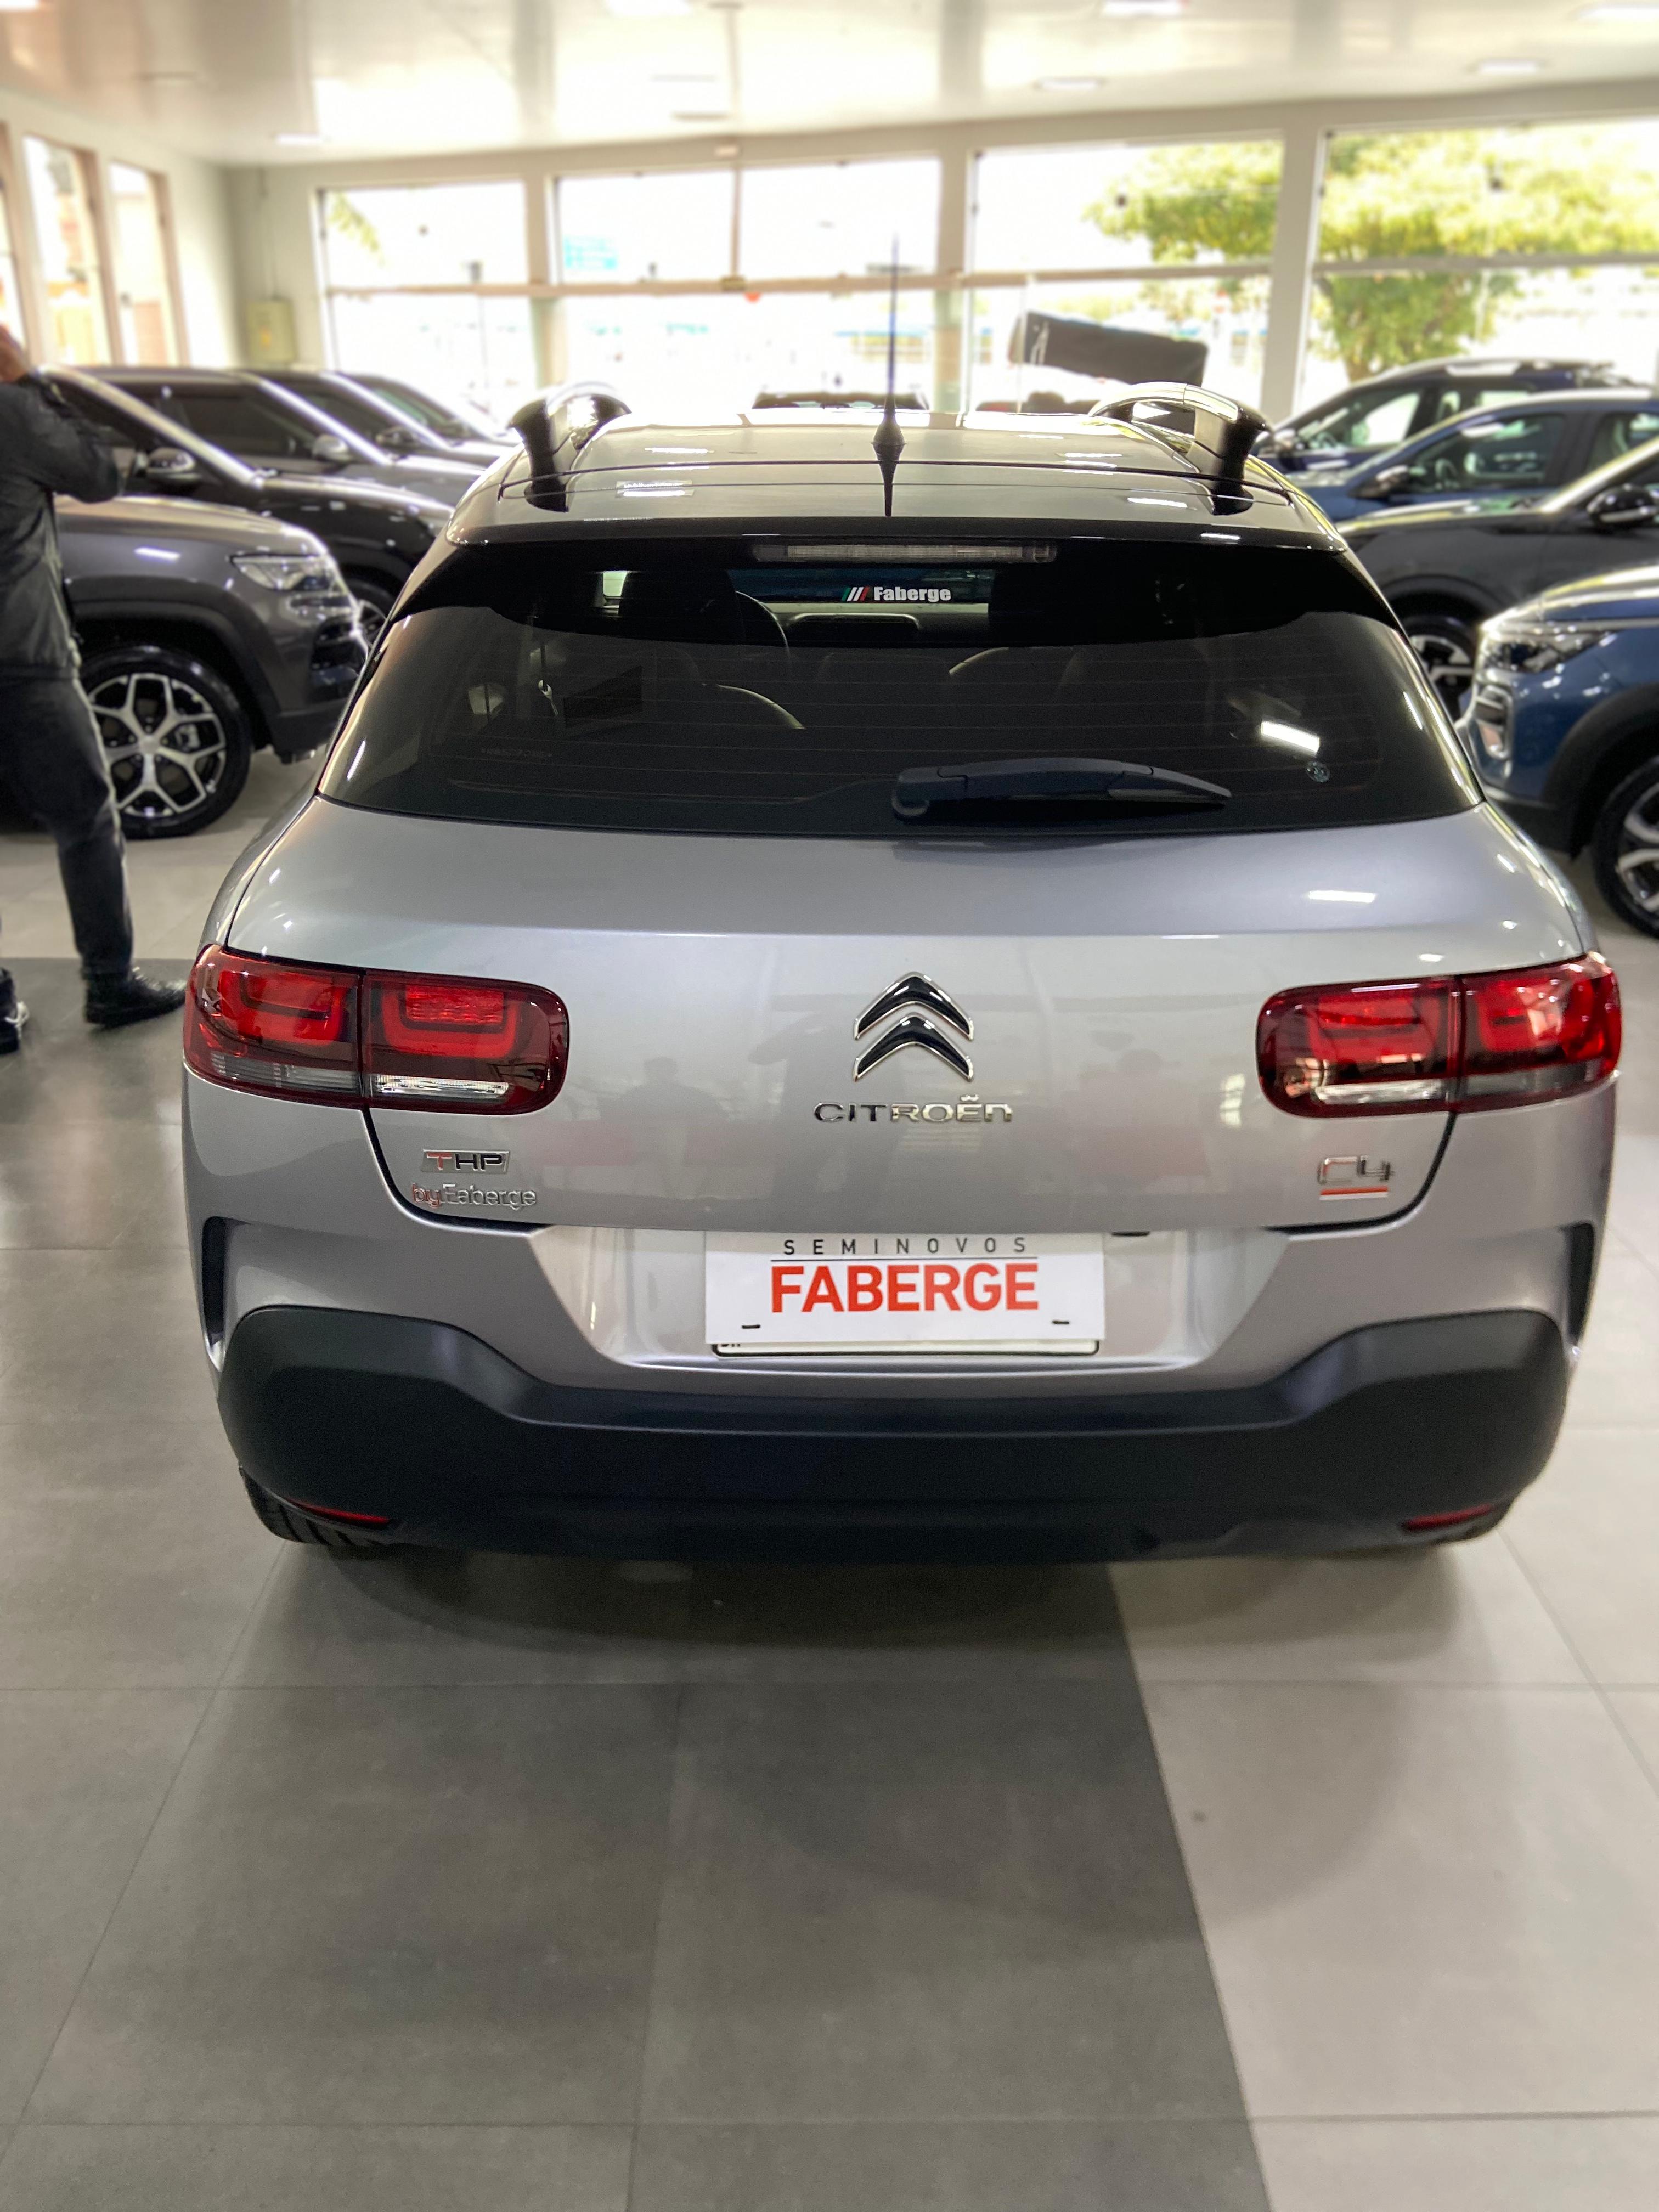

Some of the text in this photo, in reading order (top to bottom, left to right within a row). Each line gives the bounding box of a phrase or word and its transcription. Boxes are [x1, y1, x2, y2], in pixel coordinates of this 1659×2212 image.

[874, 587, 951, 602] Faberge
[426, 1152, 503, 1171] THP
[1317, 1156, 1394, 1184] C4
[412, 1182, 536, 1210] by Faberge
[783, 1237, 1026, 1255] SEMINOVOS
[771, 1263, 1039, 1312] FABERGE
